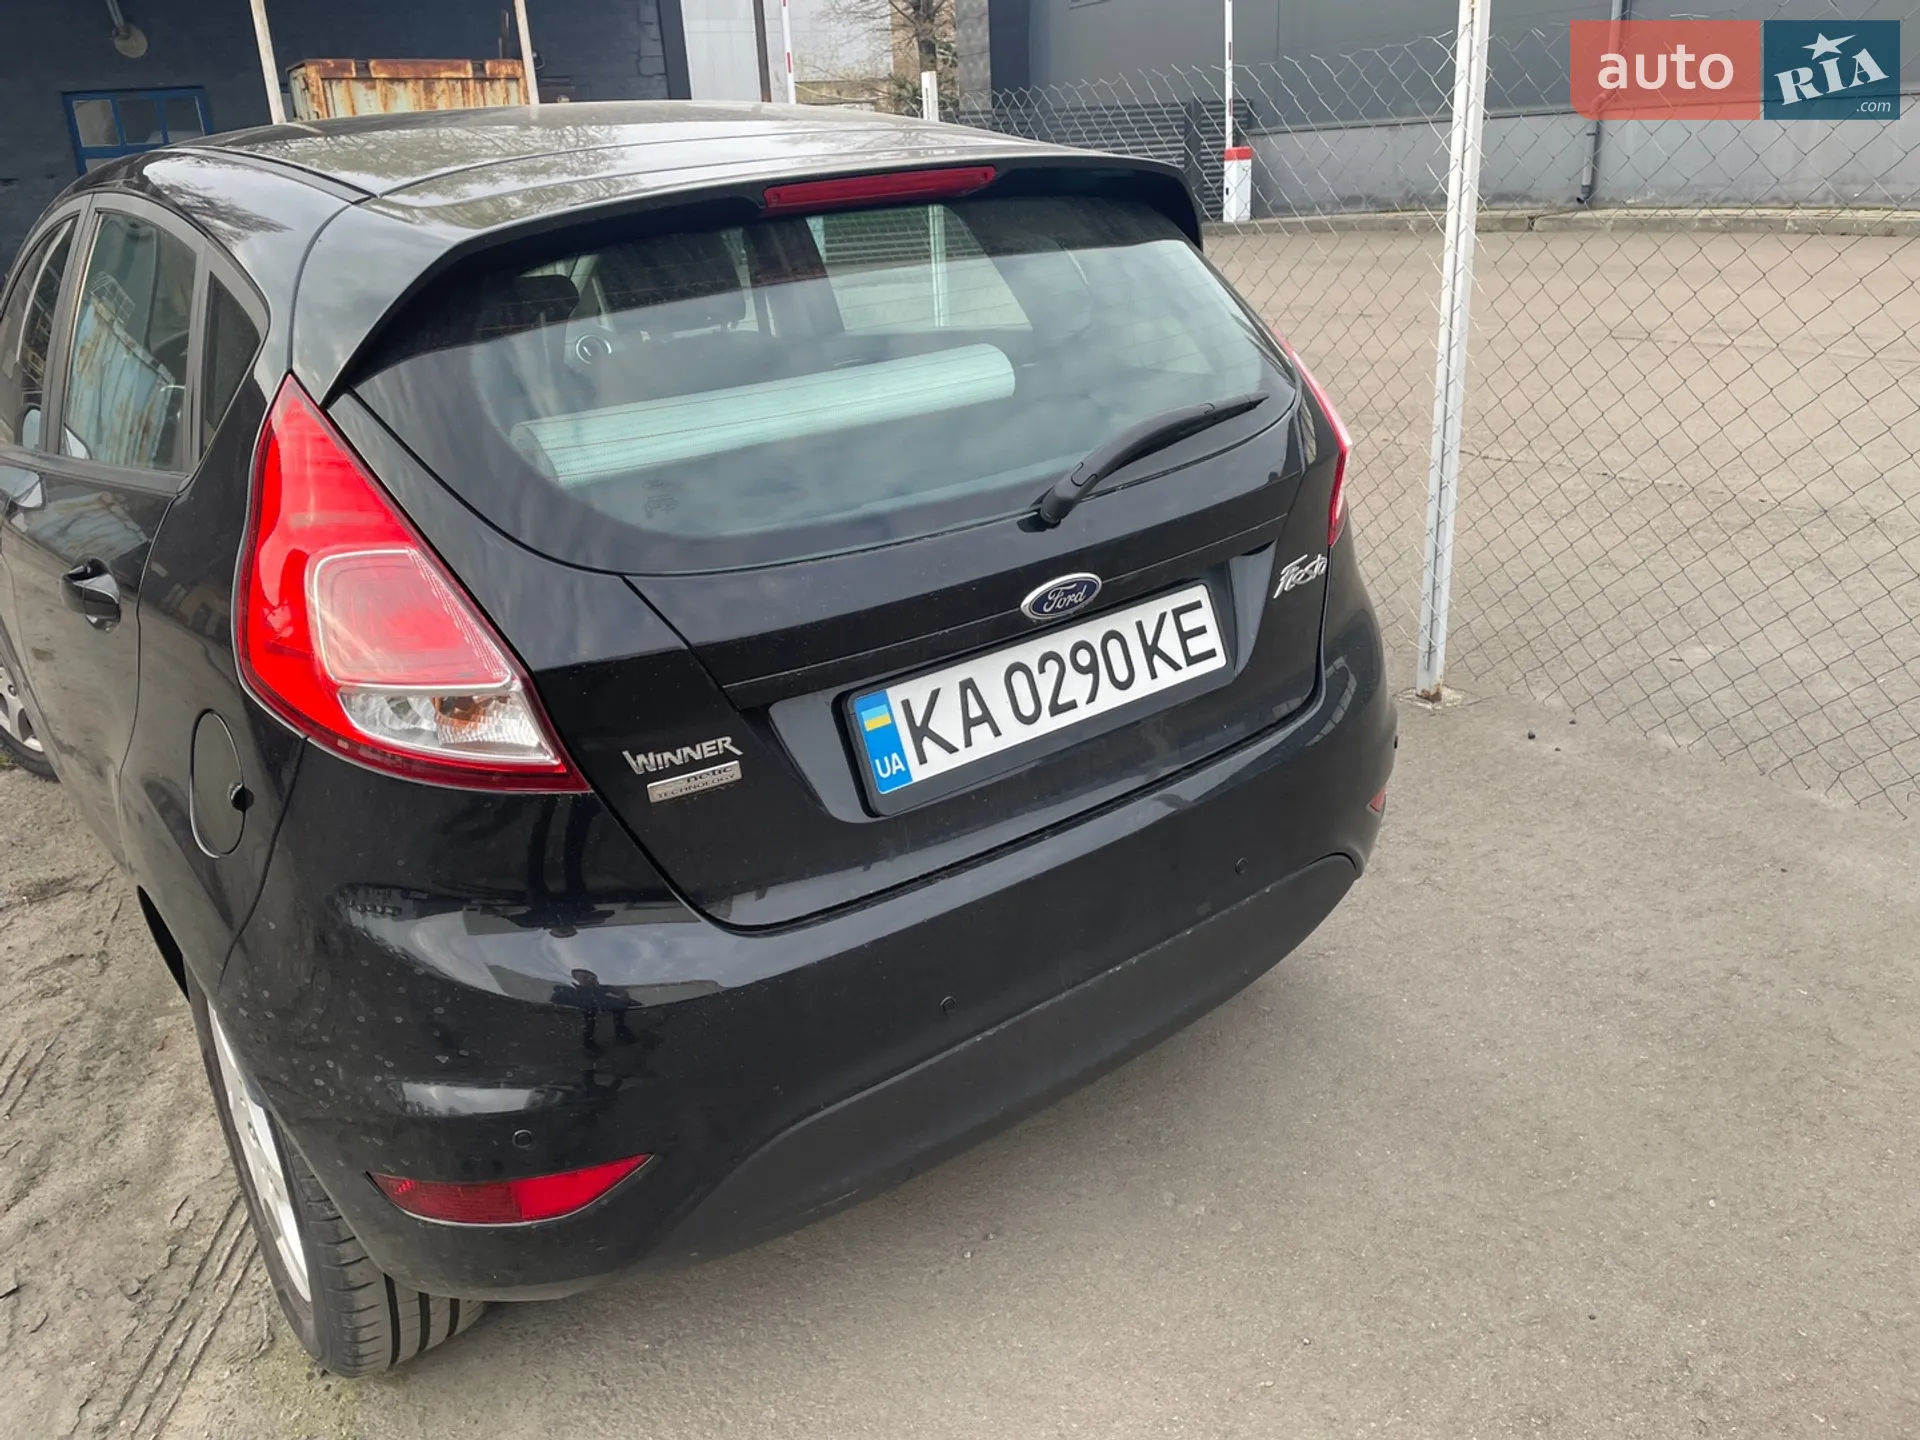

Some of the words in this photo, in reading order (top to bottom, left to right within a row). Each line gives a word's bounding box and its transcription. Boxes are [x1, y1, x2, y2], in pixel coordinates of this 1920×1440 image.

[1043, 583, 1087, 613] Ford
[900, 677, 1002, 766] KA
[1004, 629, 1135, 725] 0290
[1135, 599, 1217, 680] KE
[622, 736, 743, 775] WINNER
[875, 752, 905, 779] UA
[657, 773, 736, 799] TECHNOLOGY
